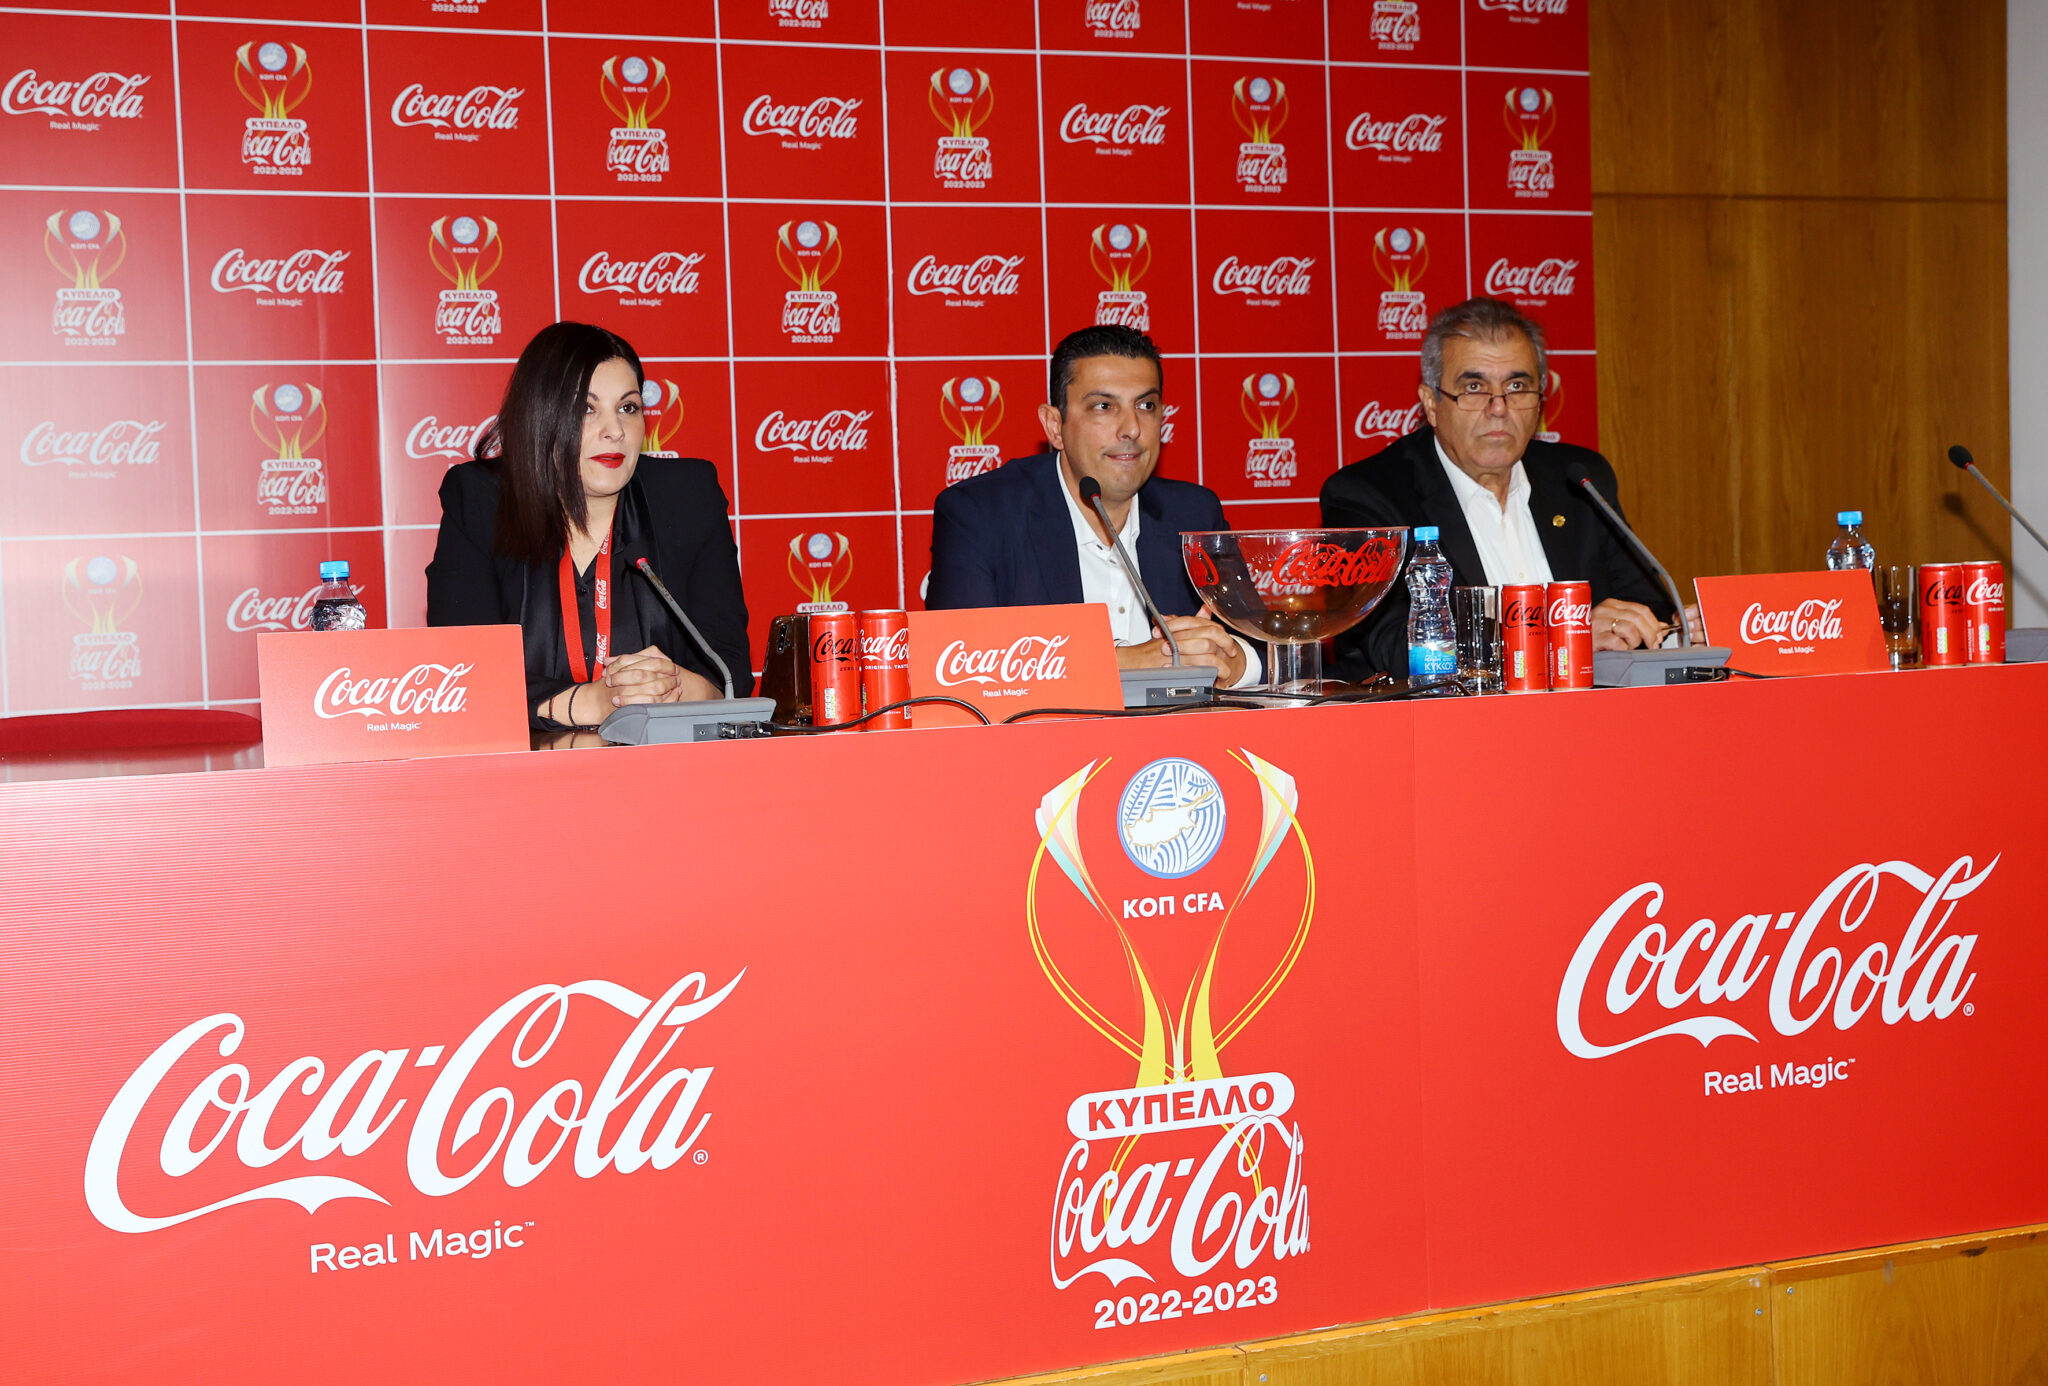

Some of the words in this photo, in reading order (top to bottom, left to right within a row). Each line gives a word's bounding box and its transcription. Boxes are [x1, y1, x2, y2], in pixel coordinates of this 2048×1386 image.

[0, 68, 151, 118] Coca-Cola
[391, 83, 525, 129] Coca-Cola
[252, 121, 301, 129] ΚΥΠΕΛΛΟ
[743, 94, 863, 139] Coca-Cola
[1060, 103, 1171, 144] Coca-Cola
[1346, 112, 1447, 153] Coca-Cola
[253, 167, 303, 175] 2022-2023
[617, 173, 662, 182] 2022-2023
[210, 248, 351, 293] Coca-Cola
[579, 250, 706, 294] Coca-Cola
[907, 255, 1025, 295] Coca-Cola
[1213, 256, 1316, 295] Coca-Cola
[1485, 258, 1580, 295] Coca-Cola
[62, 290, 115, 298] ΚΥΠΕΛΛΟ
[64, 337, 117, 346] 2022-2023
[446, 336, 493, 344] 2022-2023
[405, 414, 501, 459] Coca-C
[755, 409, 874, 452] Coca-Cola
[1355, 401, 1425, 439] Coca-C
[21, 420, 167, 466] Coca-Cola
[267, 461, 316, 469] ΚΥΠΕΛΛΟ
[268, 506, 318, 515] 2022-2023
[226, 585, 322, 632] Coca-C
[1740, 598, 1843, 645] Coca-Cola
[936, 634, 1070, 686] Coca-Cola
[1778, 647, 1793, 655] Real
[314, 662, 475, 719] Coca-Cola
[982, 689, 1001, 698] Real
[366, 723, 388, 732] Real
[1123, 896, 1174, 919] ΚΟΠ
[1183, 892, 1225, 915] CFA
[1557, 852, 2001, 1059] Coca-Cola
[84, 965, 748, 1234] Coca-Cola
[1704, 1065, 1763, 1096] Real
[1088, 1081, 1275, 1132] ΚΥΠΕΛΛΟ
[1051, 1115, 1310, 1290] Coca-Cola
[310, 1232, 398, 1274] Real
[1094, 1275, 1279, 1330] 2022-2023
